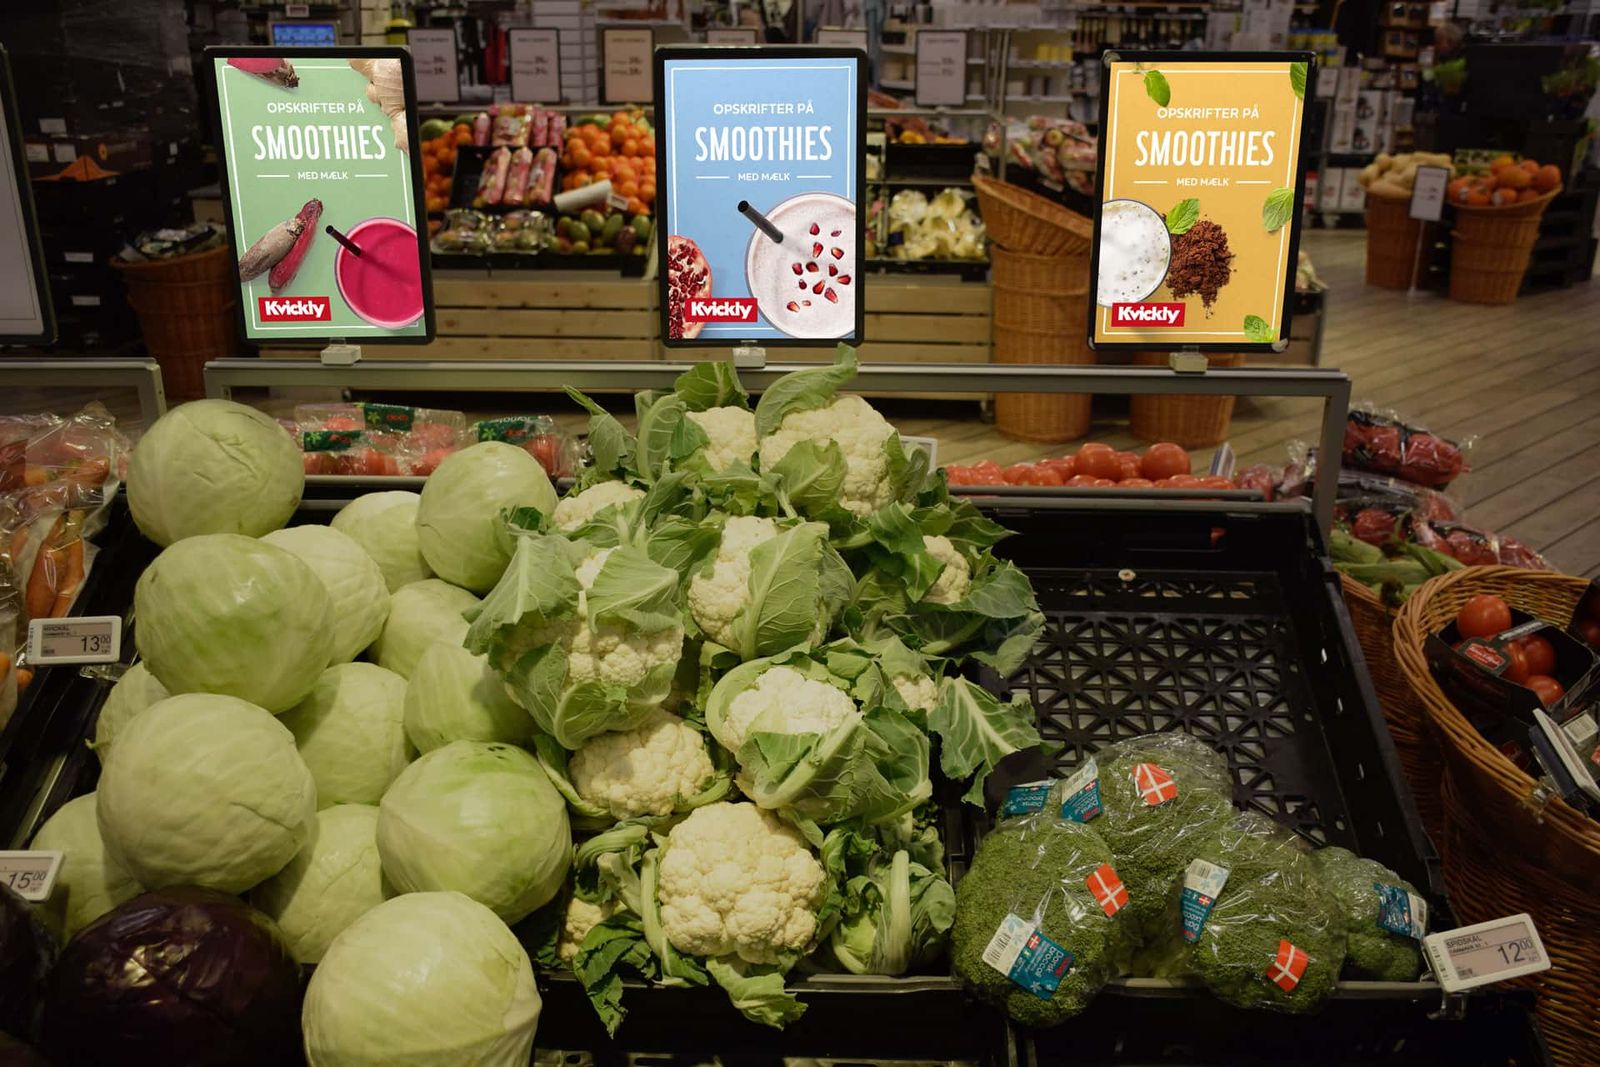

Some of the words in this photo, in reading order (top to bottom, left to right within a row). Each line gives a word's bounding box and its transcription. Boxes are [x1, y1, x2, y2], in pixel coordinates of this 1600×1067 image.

[266, 102, 346, 114] OPSKRIFTER
[347, 98, 366, 113] PÅ
[713, 103, 795, 115] OPSKRIFTER
[797, 99, 815, 114] PÅ
[1156, 107, 1240, 119] OPSKRIFTER
[1242, 104, 1260, 119] PÅ
[251, 124, 386, 161] SMOOTHIES
[695, 125, 832, 162] SMOOTHIES
[1135, 130, 1276, 167] SMOOTHIES
[297, 171, 319, 180] MED
[320, 171, 349, 180] MÆLK
[738, 172, 759, 182] MED
[761, 172, 790, 182] MÆLK
[1176, 177, 1198, 187] MED
[1200, 176, 1230, 187] MÆLK
[265, 300, 325, 318] Kvickly
[691, 301, 752, 319] Kvickly
[1118, 305, 1180, 324] Kvickly
[80, 635, 100, 653] 13
[9, 872, 33, 889] 15
[1497, 941, 1525, 965] 12
